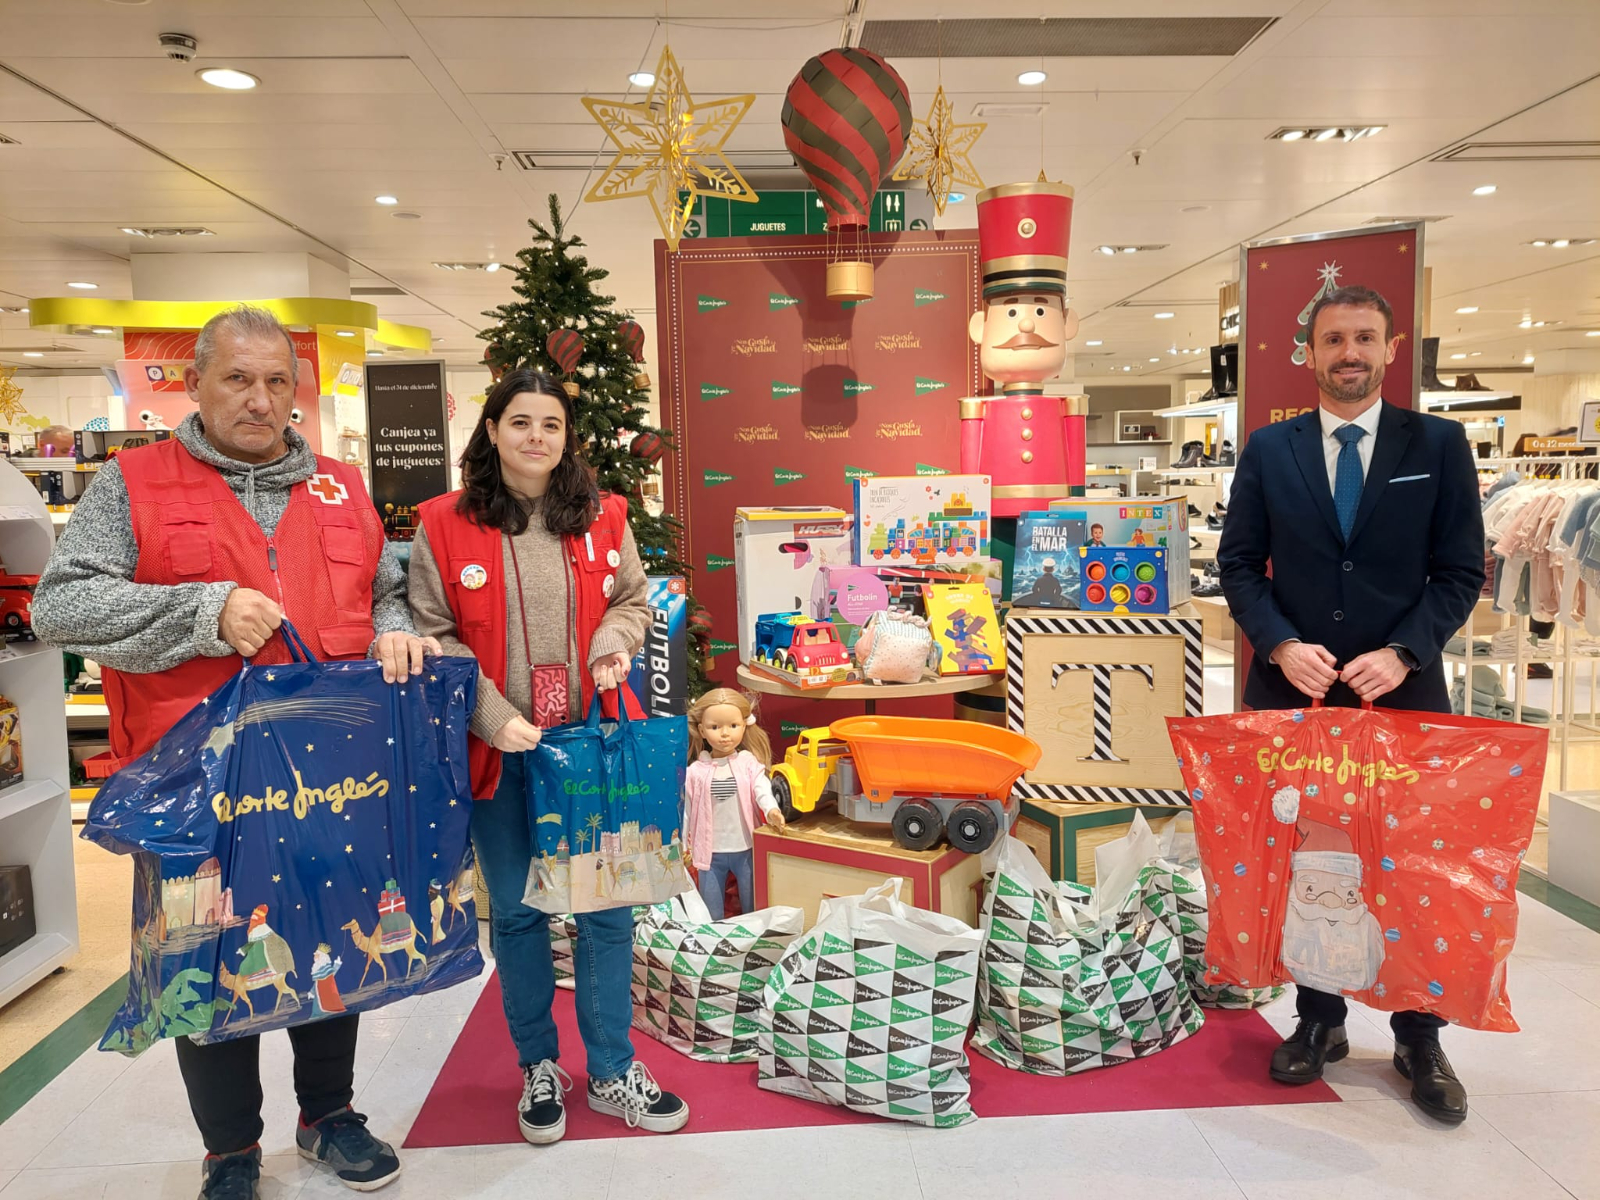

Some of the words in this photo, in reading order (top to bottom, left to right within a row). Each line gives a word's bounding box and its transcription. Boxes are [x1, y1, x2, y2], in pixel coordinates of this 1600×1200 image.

[750, 222, 786, 232] JUGUETES
[736, 342, 776, 356] Navidad
[808, 340, 848, 354] Navidad
[880, 338, 920, 352] Navidad
[380, 427, 420, 439] Canjea
[423, 428, 436, 440] ya
[739, 430, 779, 444] Navidad
[810, 428, 850, 442] Navidad
[882, 426, 922, 440] Navidad
[375, 442, 392, 452] tus
[395, 443, 444, 453] cupones
[1532, 440, 1539, 448] 0
[1546, 440, 1557, 448] 12
[376, 456, 390, 466] de
[1120, 507, 1162, 518] INTEX
[1032, 526, 1067, 537] BATALLA
[1040, 537, 1066, 551] MAR
[649, 605, 674, 718] FUTBOLÍ
[1052, 663, 1154, 763] T
[1257, 748, 1279, 773] El
[1280, 748, 1334, 774] Corte
[1336, 744, 1420, 788] Inglés
[234, 786, 290, 817] orte
[294, 771, 389, 820] Inglés
[564, 779, 578, 795] El
[608, 778, 650, 803] Inglés
